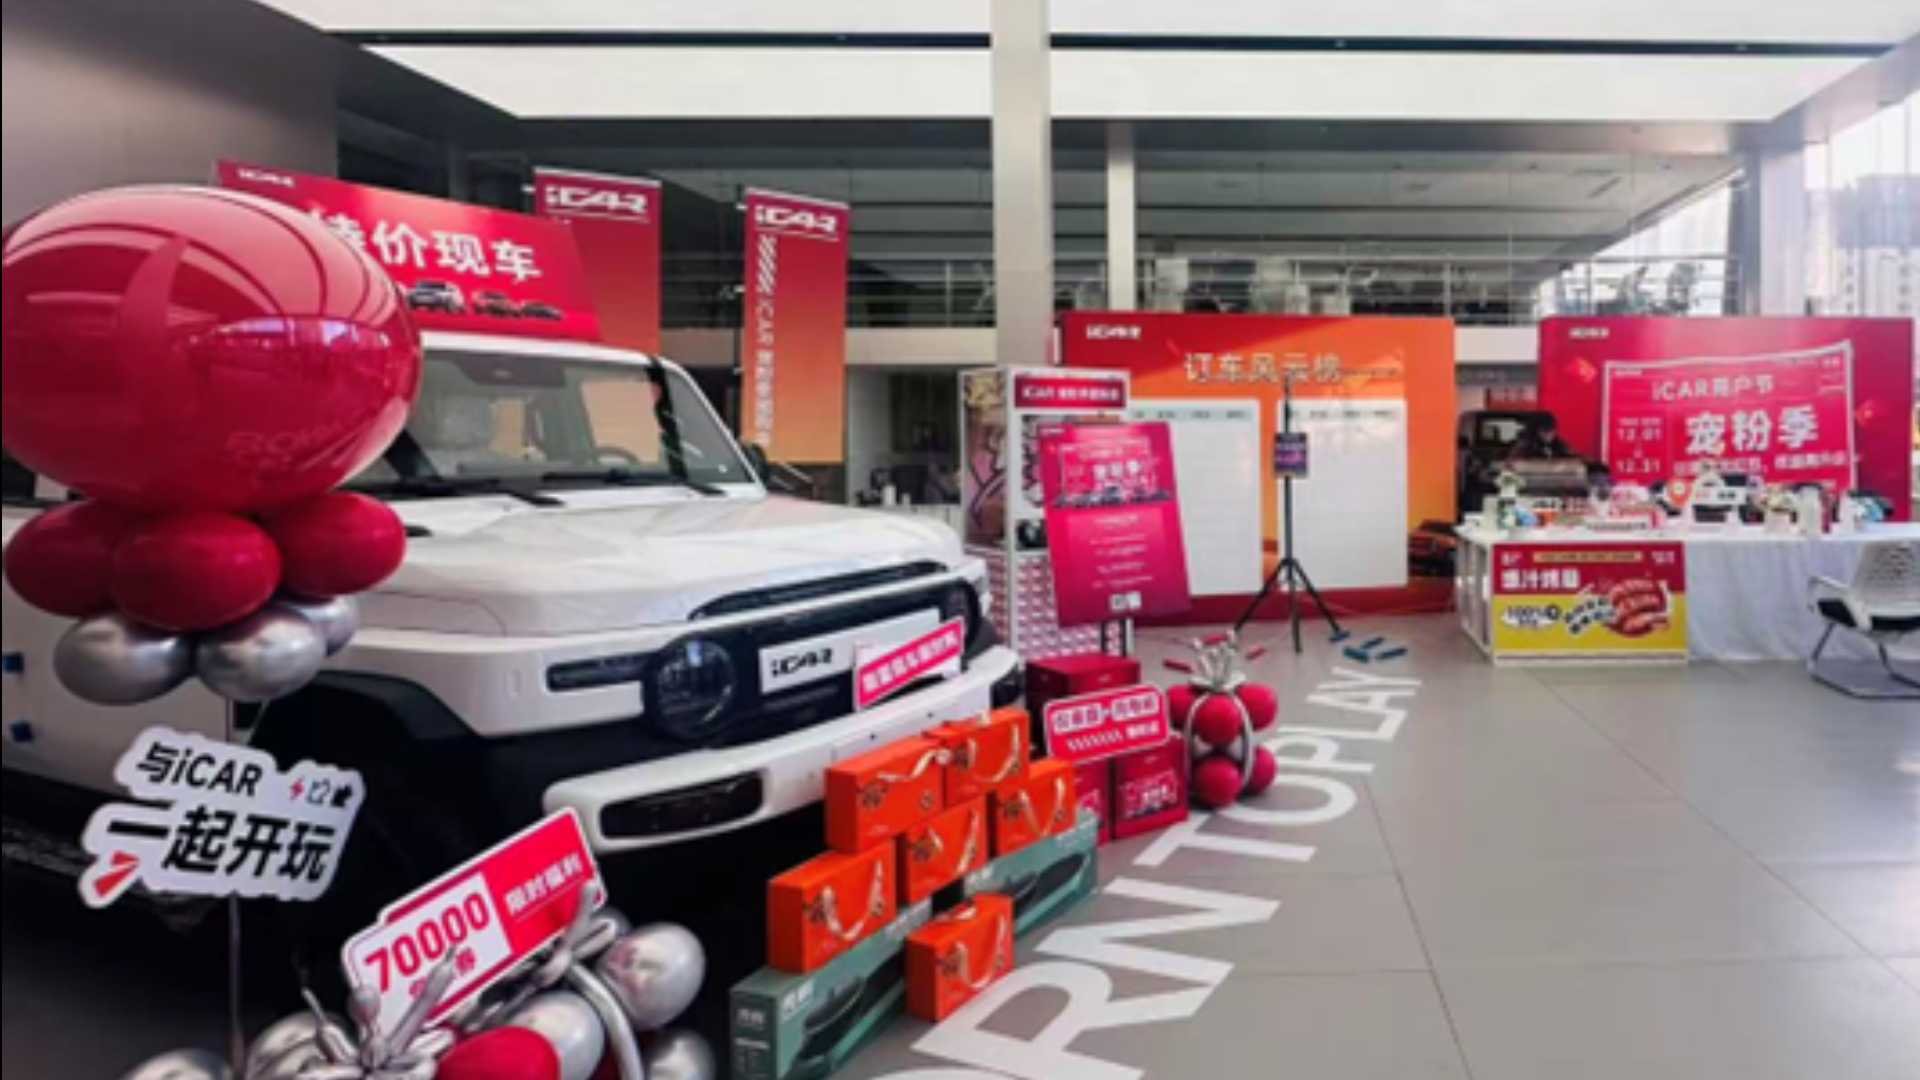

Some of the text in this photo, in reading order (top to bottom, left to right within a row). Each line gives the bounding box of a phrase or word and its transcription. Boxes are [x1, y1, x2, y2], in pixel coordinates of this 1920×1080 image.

[545, 184, 648, 214] iCAR
[755, 204, 838, 233] iCAR
[1617, 427, 1662, 442] 12.01
[1684, 404, 1819, 455] 宠粉季
[1616, 459, 1661, 474] 12.31
[107, 805, 335, 882] 一起开玩
[364, 892, 490, 993] 70000
